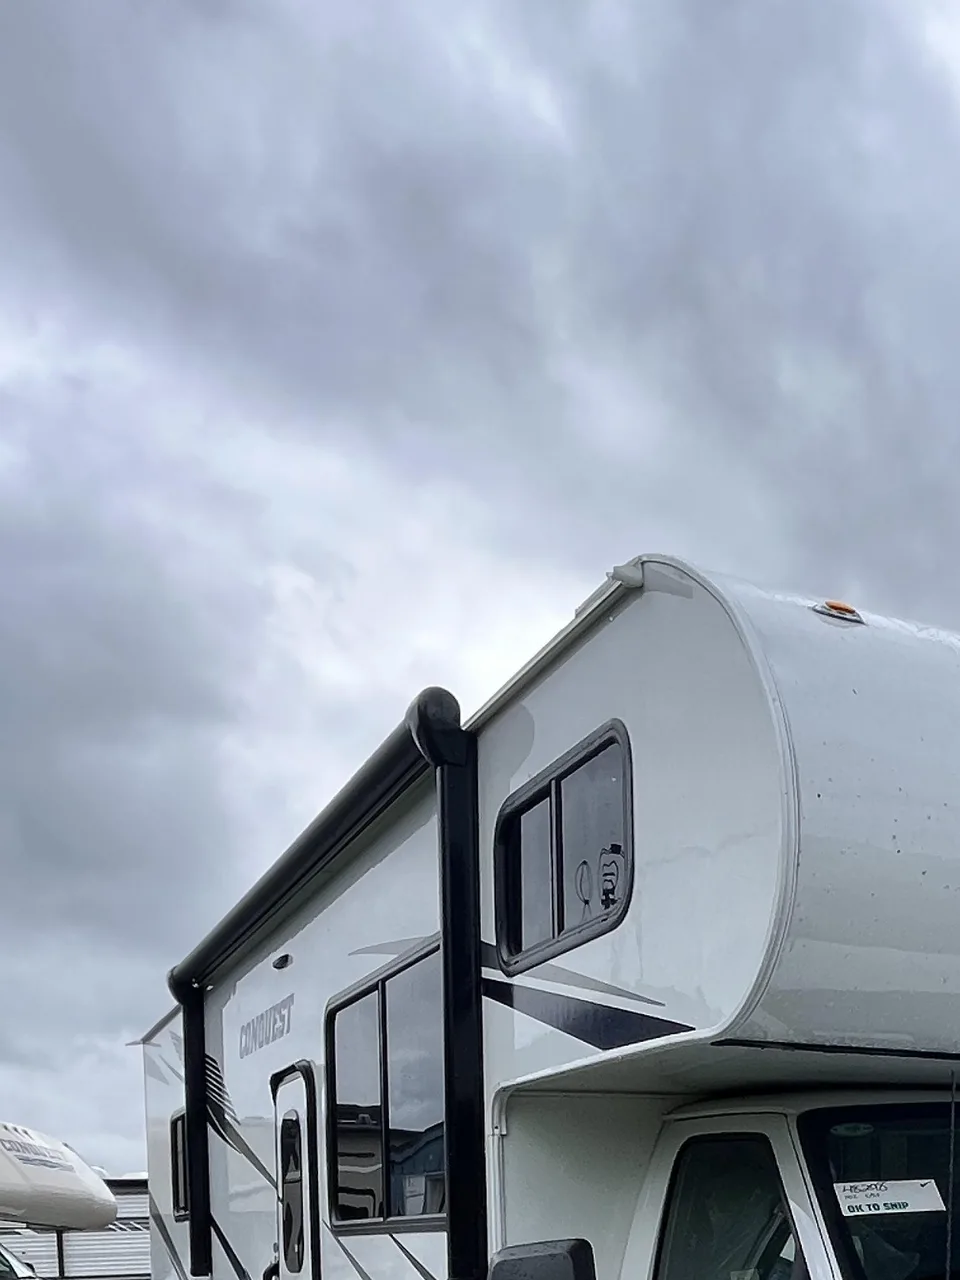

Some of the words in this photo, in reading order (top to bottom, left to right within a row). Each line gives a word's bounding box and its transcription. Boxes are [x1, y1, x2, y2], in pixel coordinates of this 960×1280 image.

[847, 1203, 865, 1213] OK
[865, 1202, 880, 1211] TO
[883, 1201, 909, 1211] SHIP
